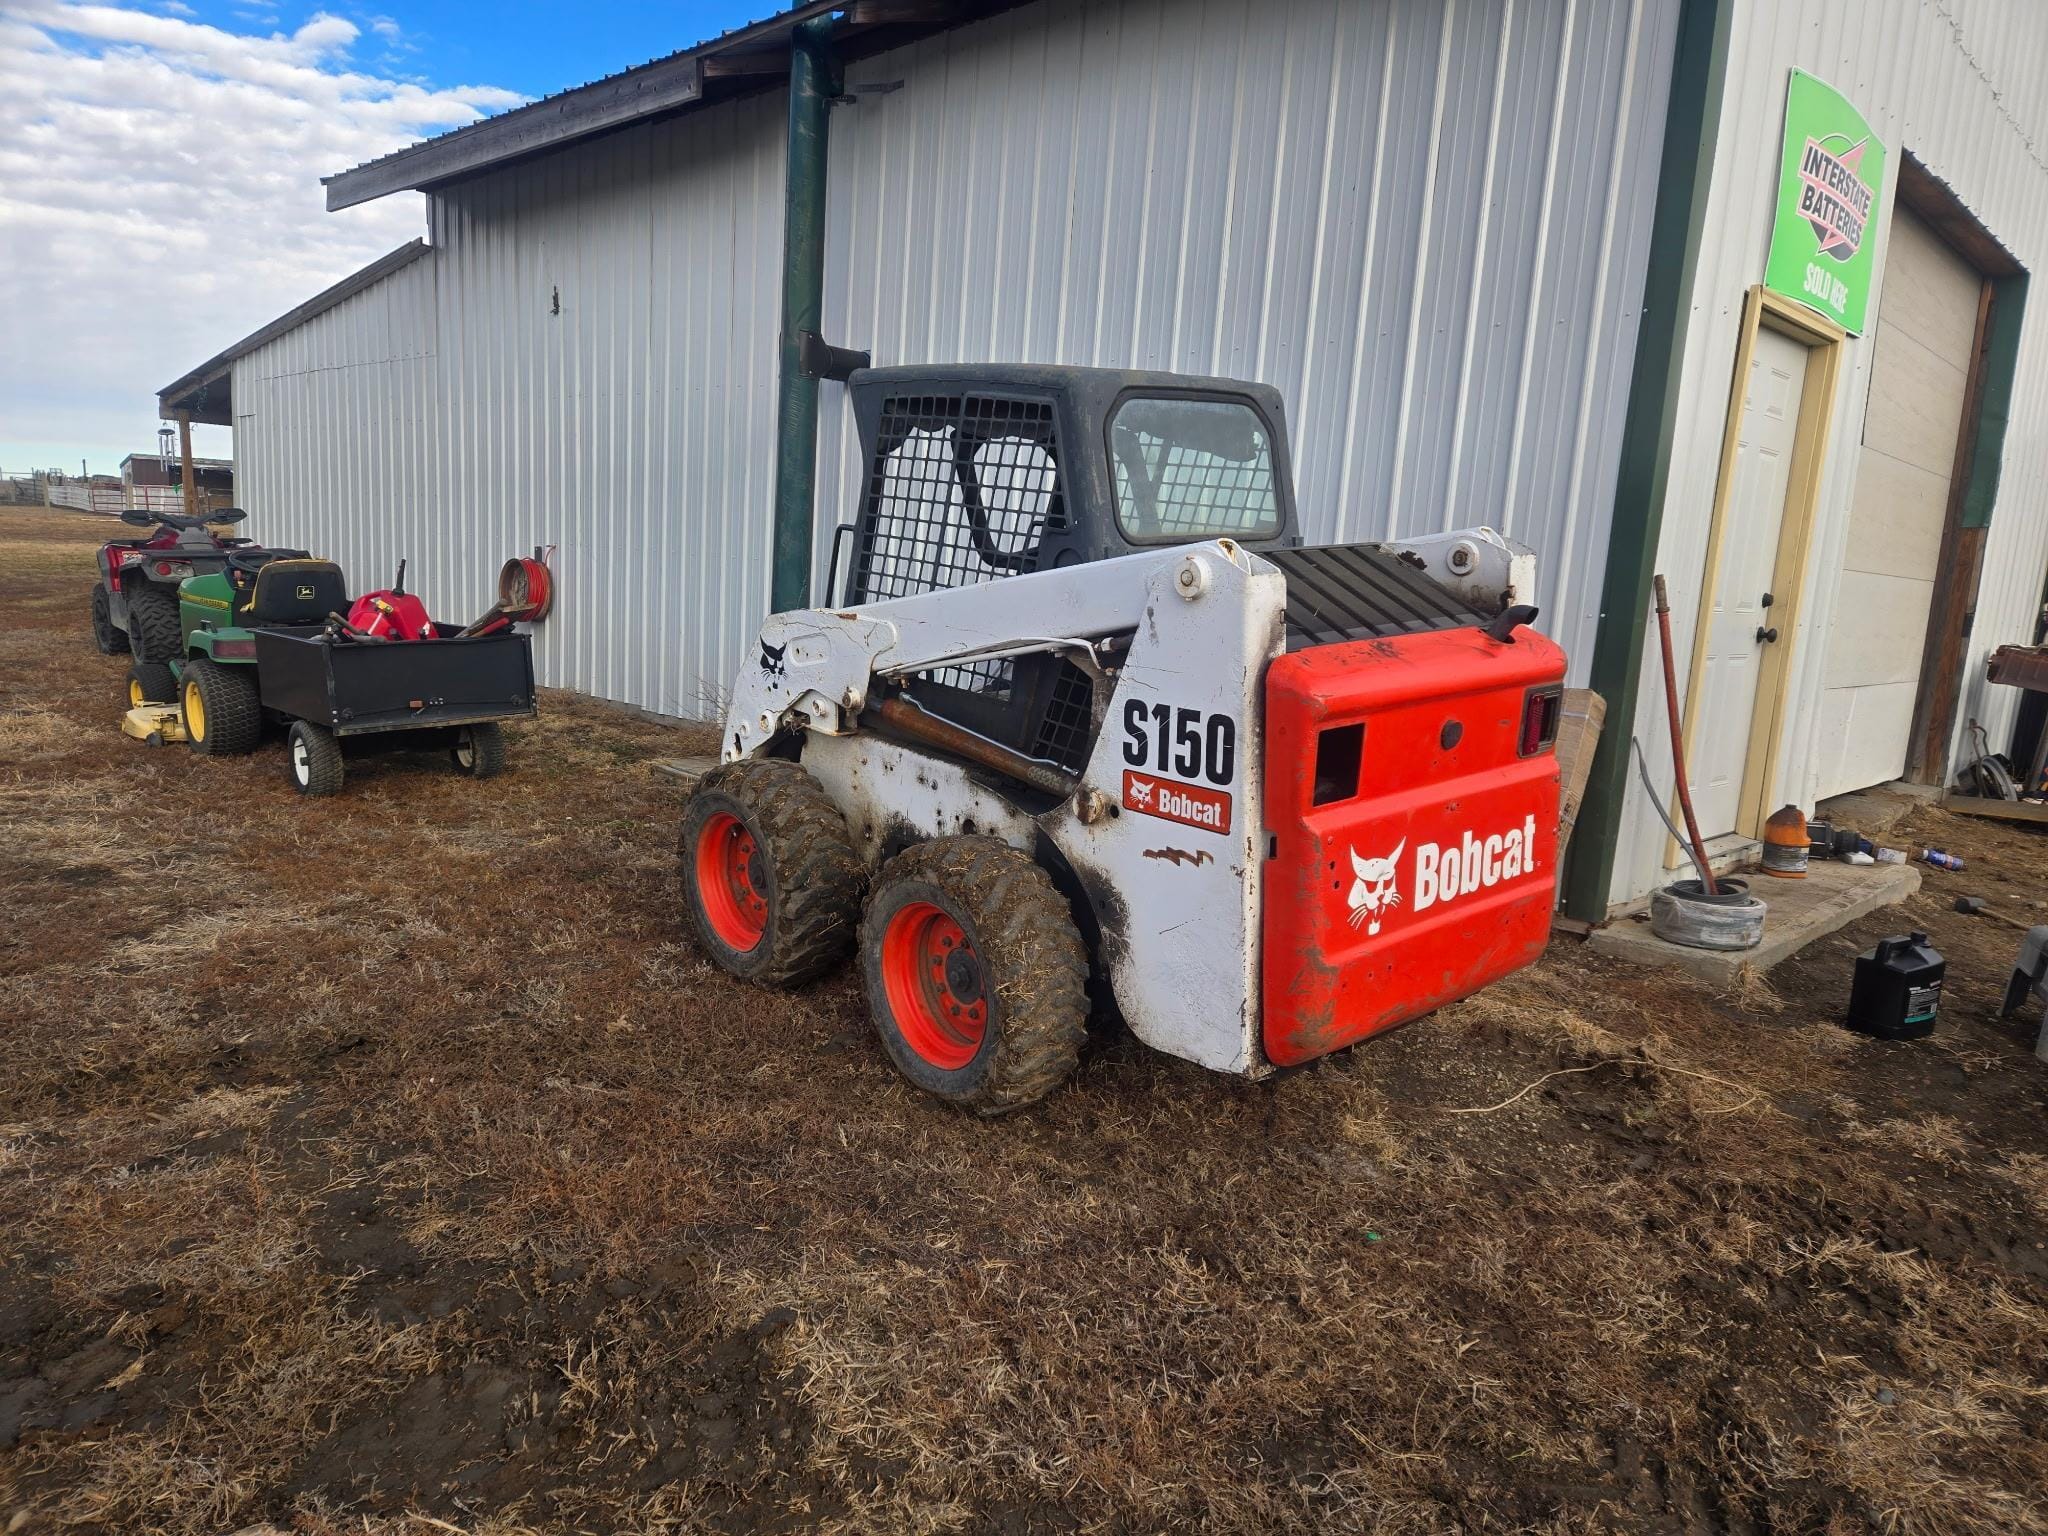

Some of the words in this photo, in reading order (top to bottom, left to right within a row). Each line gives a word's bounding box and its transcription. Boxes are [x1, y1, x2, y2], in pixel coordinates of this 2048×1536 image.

[1801, 183, 1862, 247] BATTERIES
[1803, 145, 1871, 218] INTERSTATE
[1804, 262, 1831, 300] SOLD
[1123, 699, 1235, 785] S150
[1159, 788, 1221, 827] Bobcat
[1414, 814, 1536, 912] Bobcat
